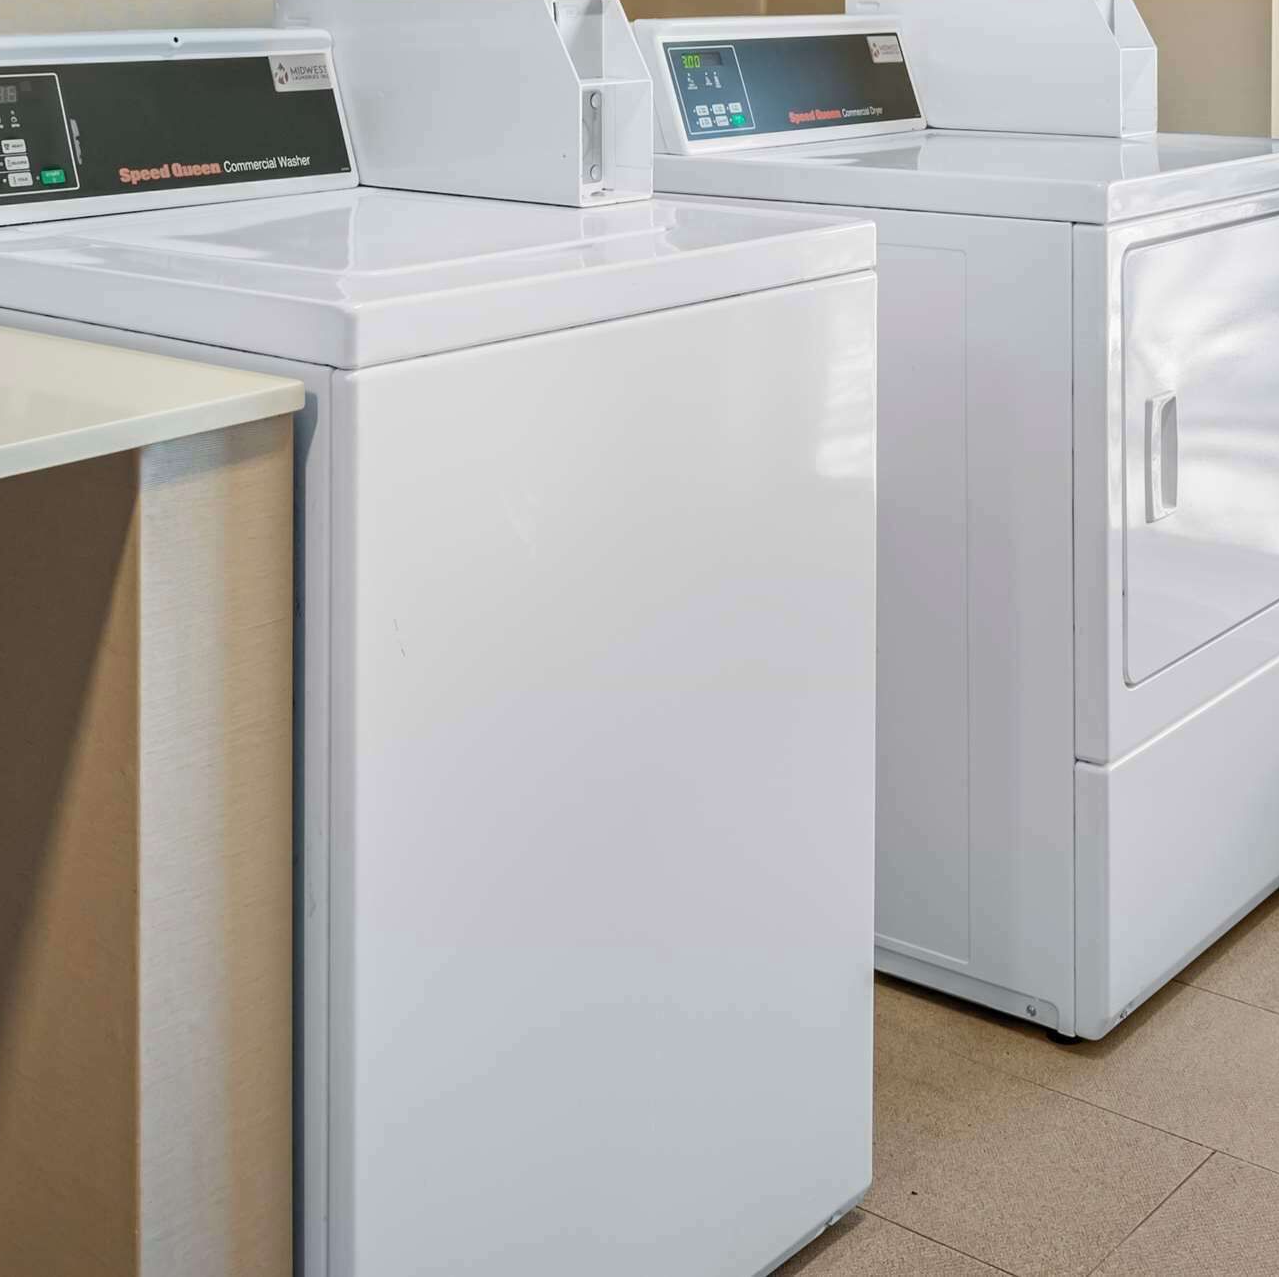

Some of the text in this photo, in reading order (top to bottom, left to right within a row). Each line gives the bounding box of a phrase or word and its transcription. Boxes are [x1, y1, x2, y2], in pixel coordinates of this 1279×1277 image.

[119, 155, 311, 185] Speed Queen Commercial Washer
